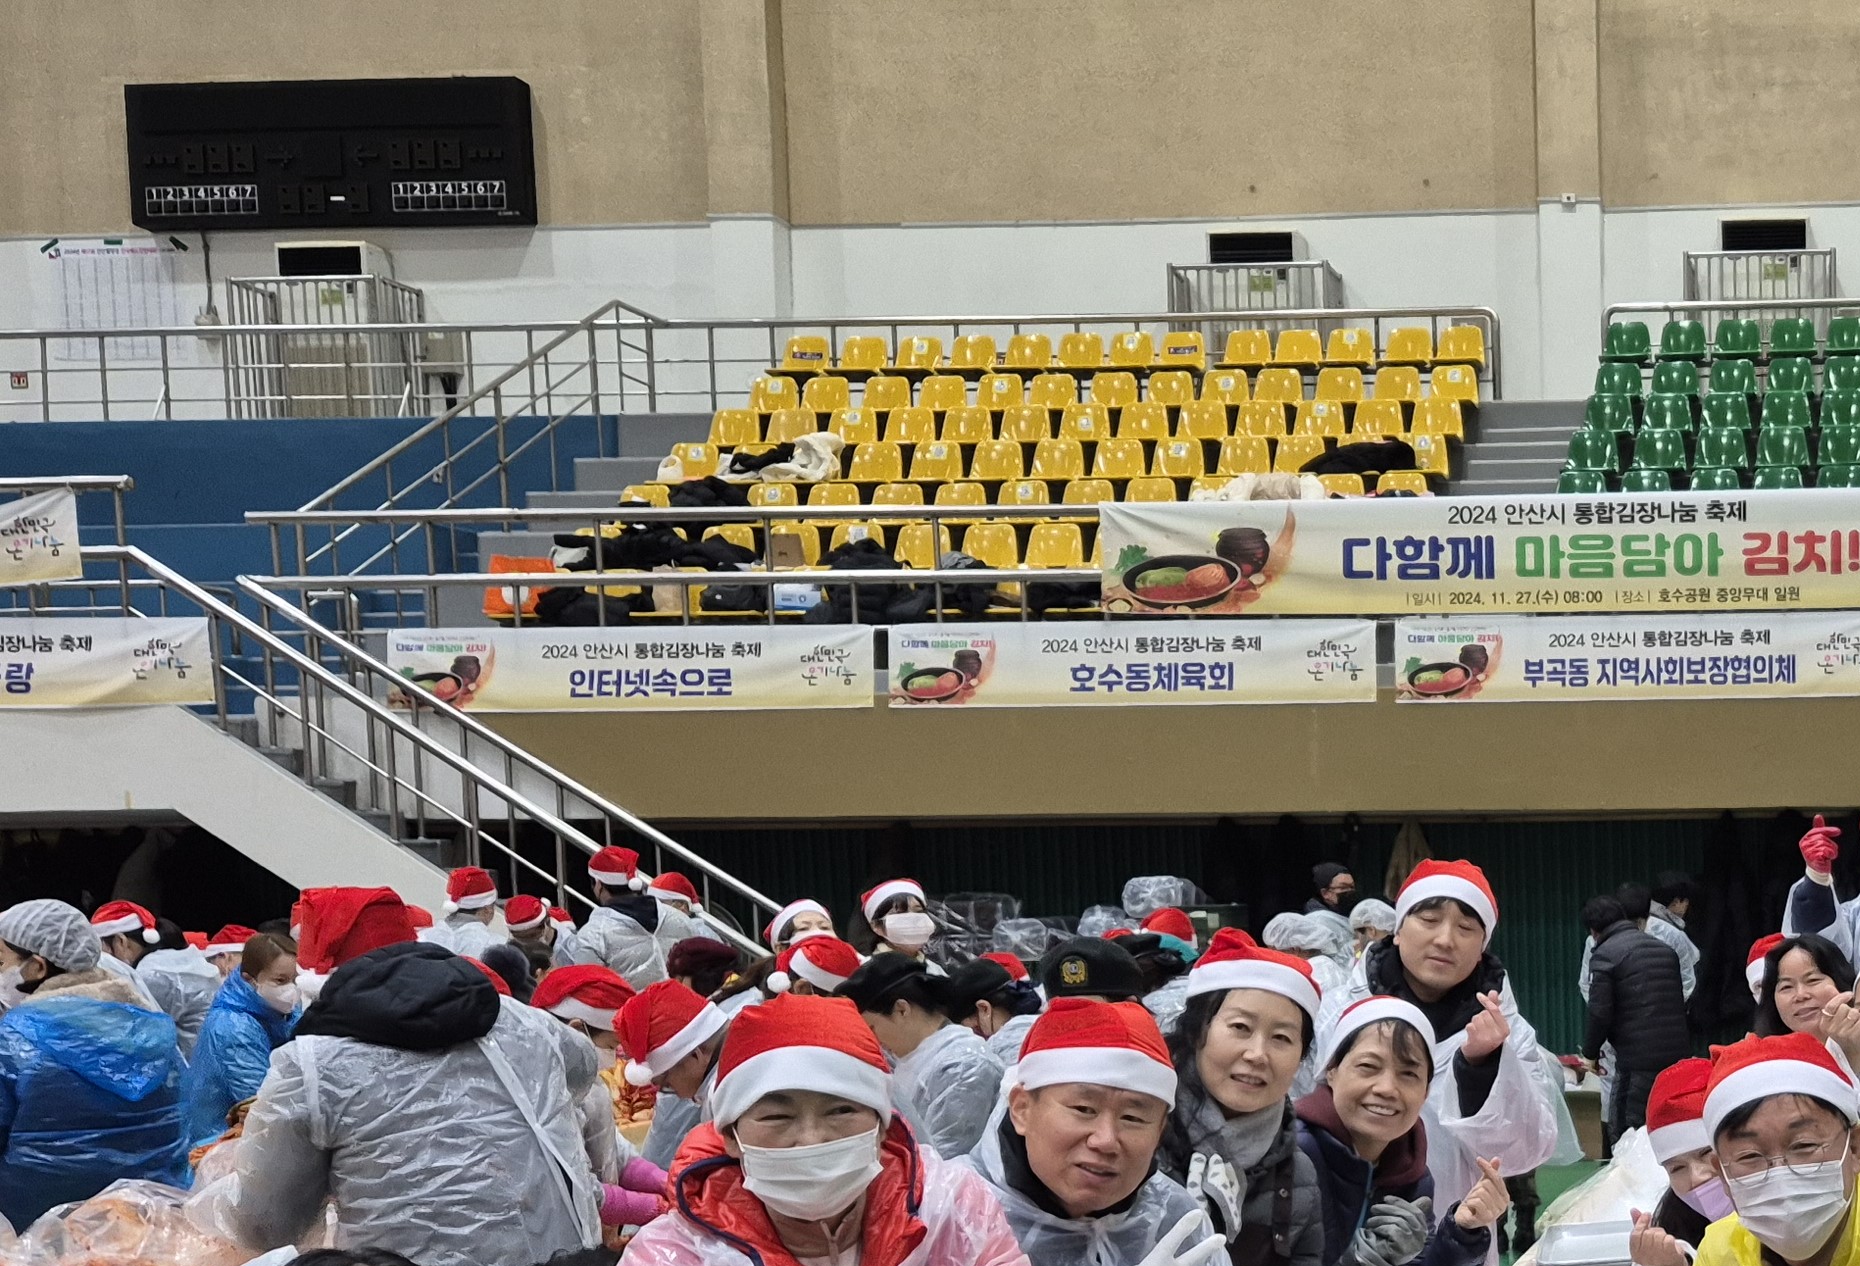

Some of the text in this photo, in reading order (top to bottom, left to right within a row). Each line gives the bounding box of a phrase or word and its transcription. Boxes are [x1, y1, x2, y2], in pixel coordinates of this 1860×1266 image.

[1448, 499, 1747, 526] 2024 안산시 통합김장나눔 축제
[1341, 528, 1860, 581] 다함께 마음담아 김치!
[1449, 591, 1484, 605] 2024.
[1563, 590, 1604, 605] 08:00
[1658, 586, 1711, 604] 호수공원
[1715, 585, 1770, 603] 중앙무대
[1773, 585, 1801, 602] 일원
[0, 634, 93, 654] 장나눔 축제
[541, 641, 762, 660] 2024 안산시 통합김장나눔 축제
[1041, 635, 1263, 654] 2024 안산시 통합김장나눔 축제
[1548, 628, 1771, 649] 2024 안산시 통합김장나눔 축제
[568, 667, 734, 698] 인터넷속으로
[1069, 661, 1235, 692] 호수동체육회
[1523, 653, 1797, 689] 부곡동 지역사회보장협의체
